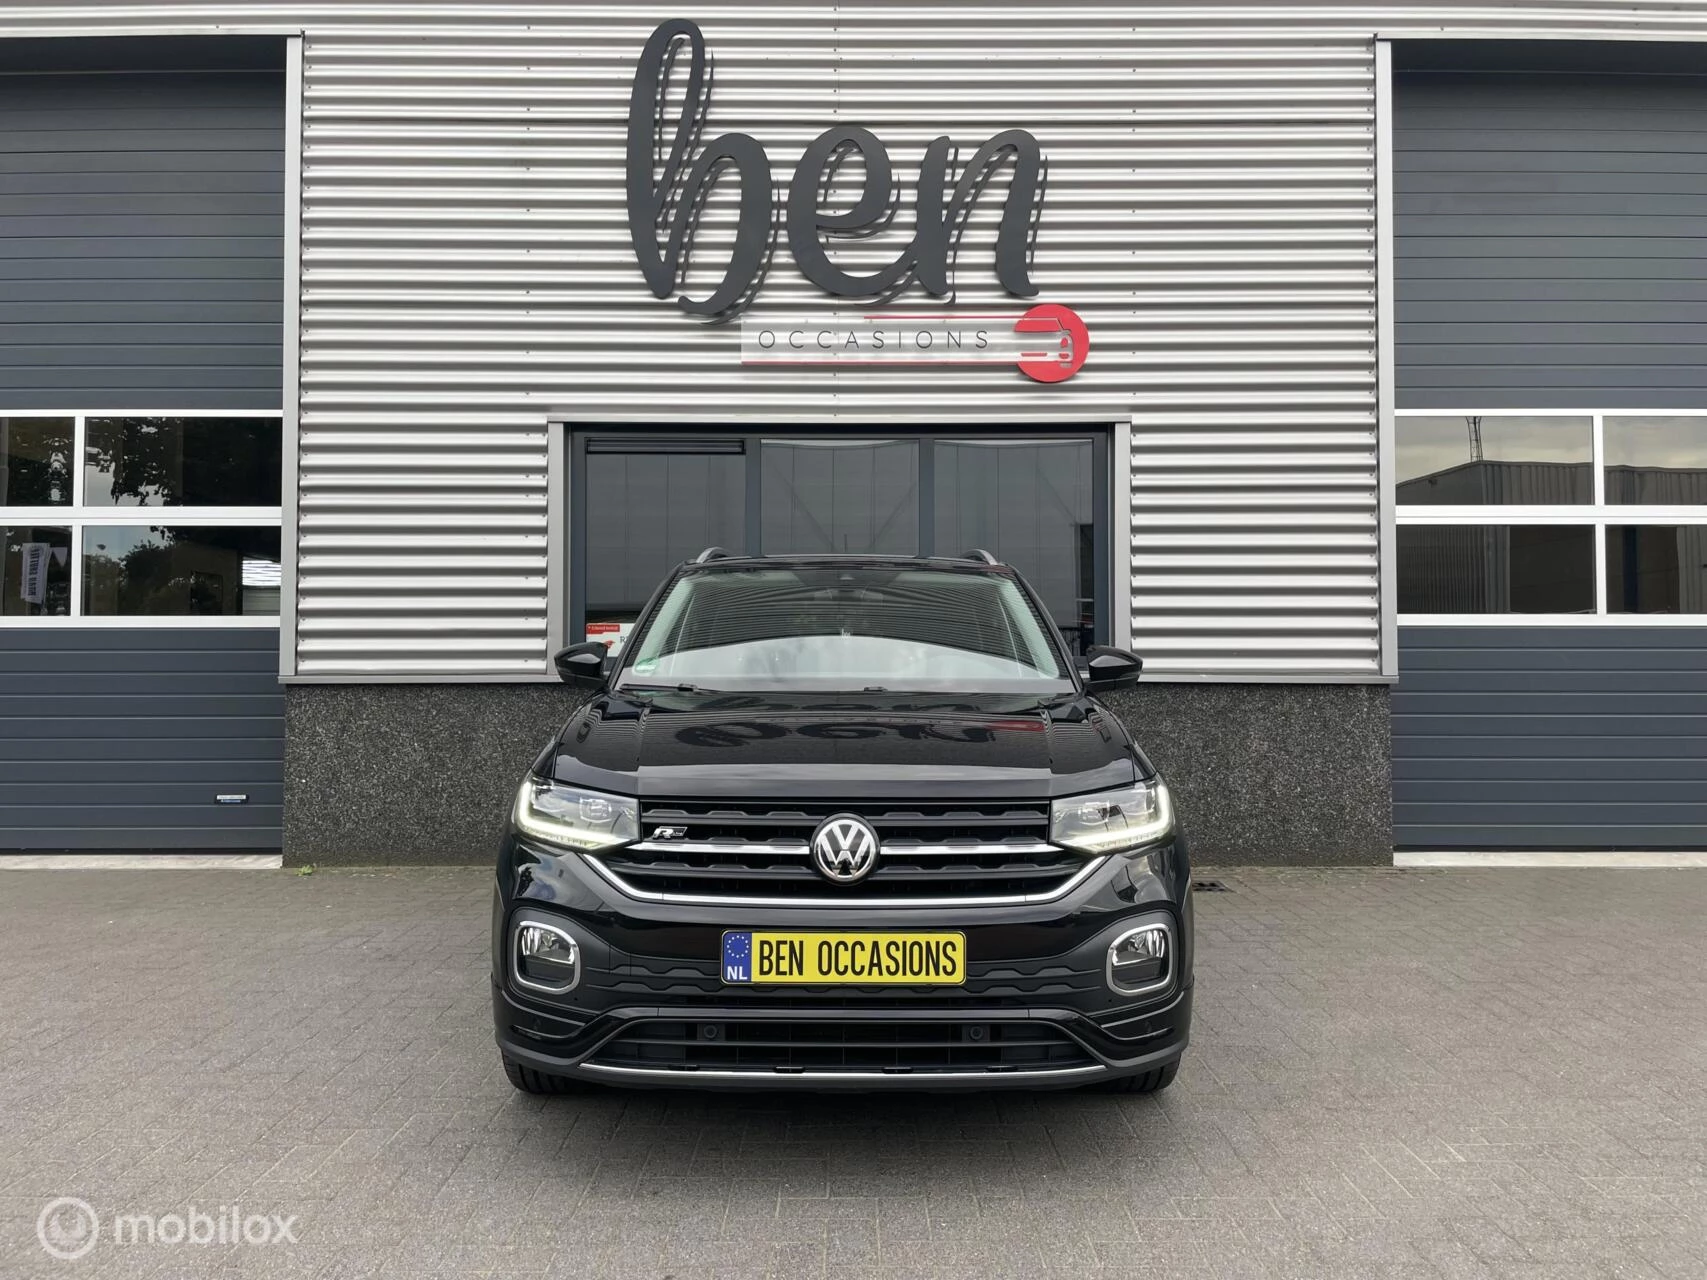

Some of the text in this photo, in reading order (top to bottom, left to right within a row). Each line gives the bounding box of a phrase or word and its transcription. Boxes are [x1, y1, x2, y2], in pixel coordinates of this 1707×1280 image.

[626, 18, 1041, 316] ben
[758, 330, 988, 349] OCCASIONS
[758, 940, 957, 977] BEN OCCASIONS
[727, 966, 748, 980] NL
